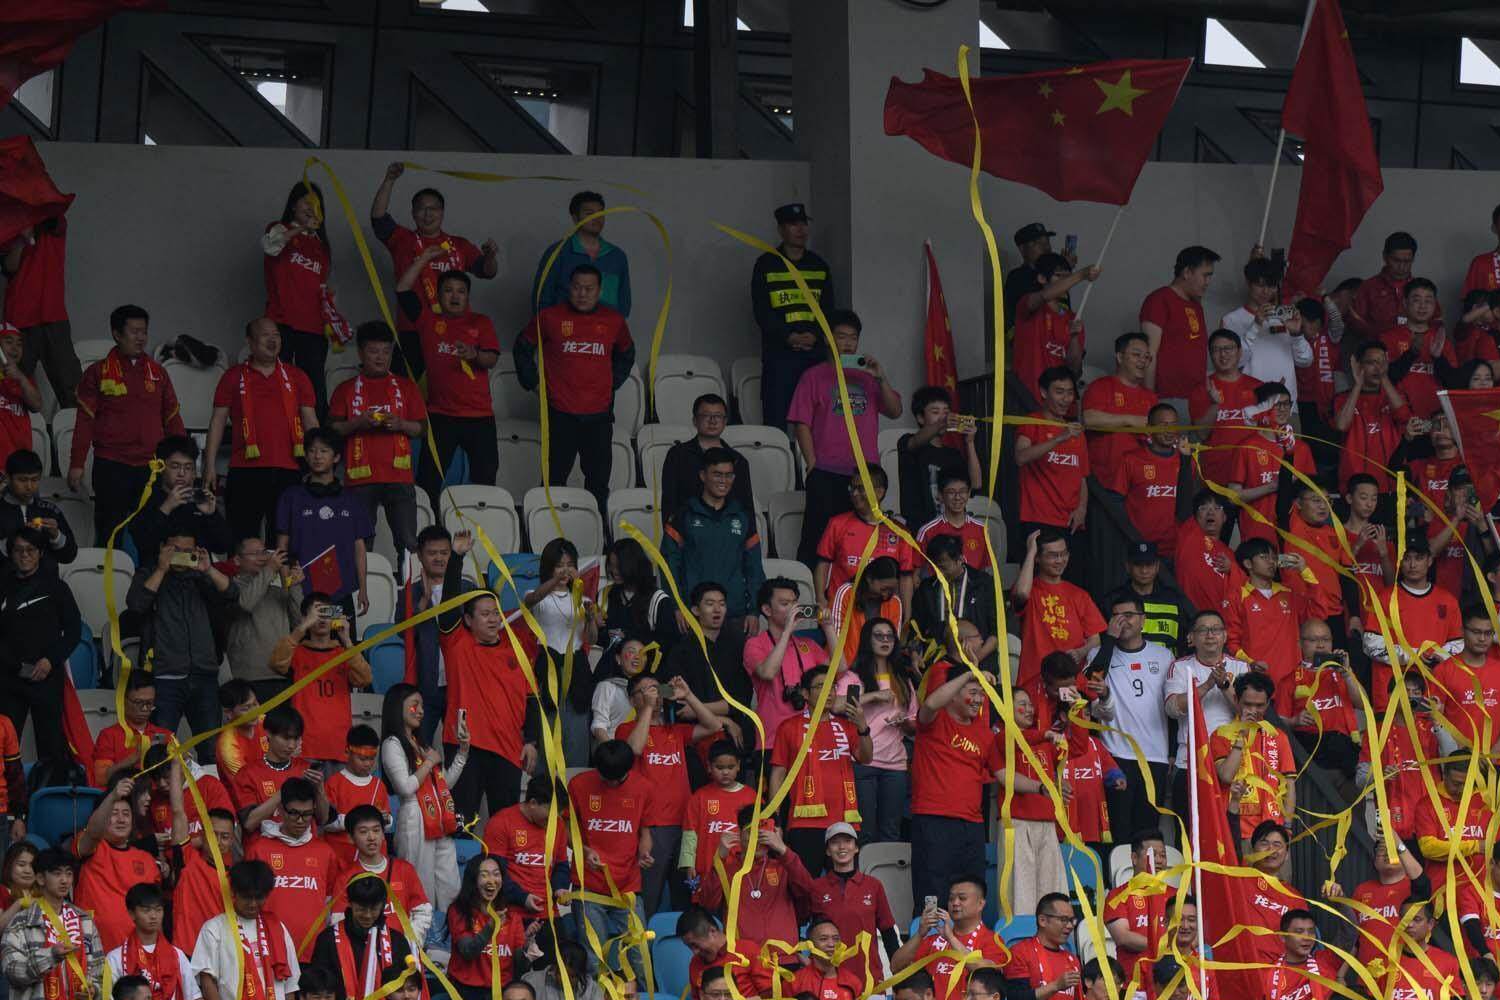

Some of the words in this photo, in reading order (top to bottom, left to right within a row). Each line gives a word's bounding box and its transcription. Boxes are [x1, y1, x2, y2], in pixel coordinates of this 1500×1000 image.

[563, 341, 605, 355] 龙之队
[1216, 408, 1244, 421] 龙之
[1146, 485, 1177, 498] 龙之
[1428, 479, 1449, 490] 龙之
[318, 678, 333, 697] 10
[1132, 679, 1144, 696] 9
[588, 818, 633, 833] 龙之队
[708, 821, 737, 833] 龙之
[515, 852, 545, 866] 龙之
[274, 875, 318, 890] 龙之队
[937, 961, 956, 974] 龙之
